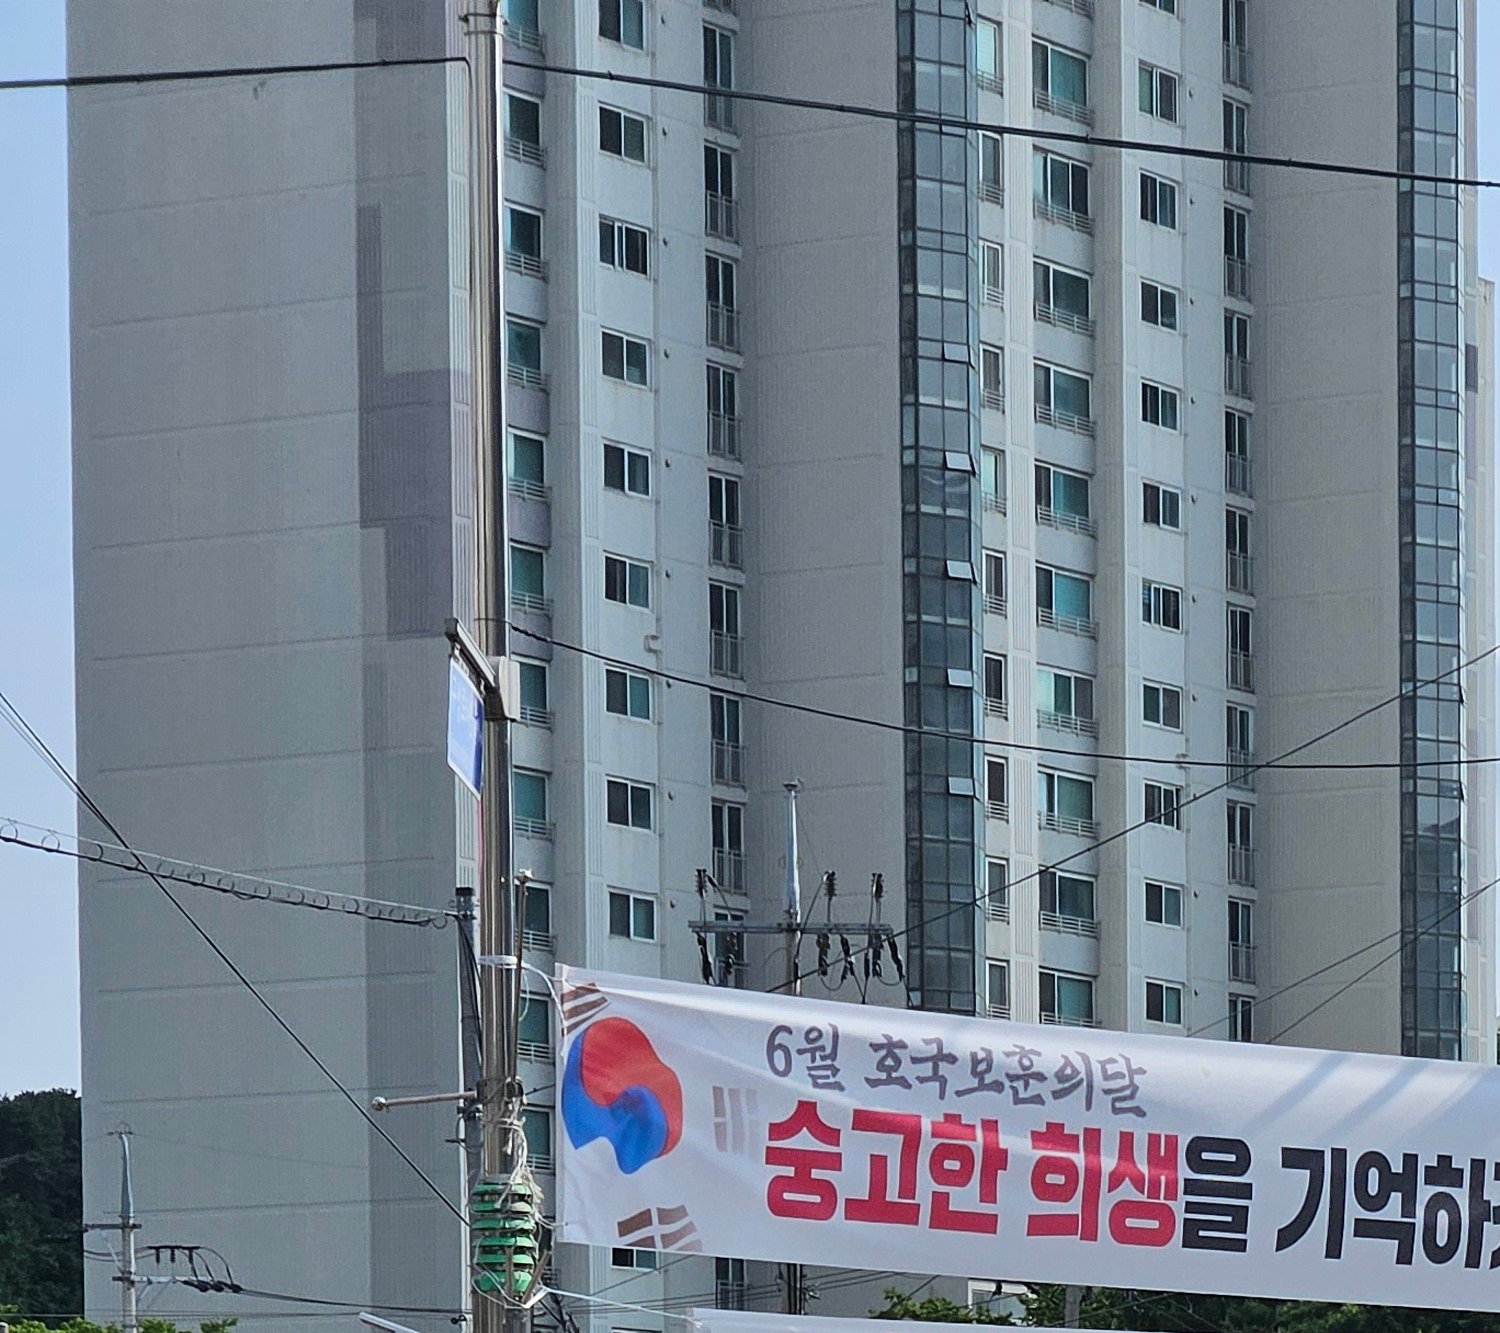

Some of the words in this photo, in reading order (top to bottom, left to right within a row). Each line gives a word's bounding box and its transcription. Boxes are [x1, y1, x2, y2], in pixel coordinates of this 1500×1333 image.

[766, 1023, 846, 1092] 6월
[765, 1100, 1009, 1236] 숭고한
[1026, 1121, 1255, 1253] 희생을
